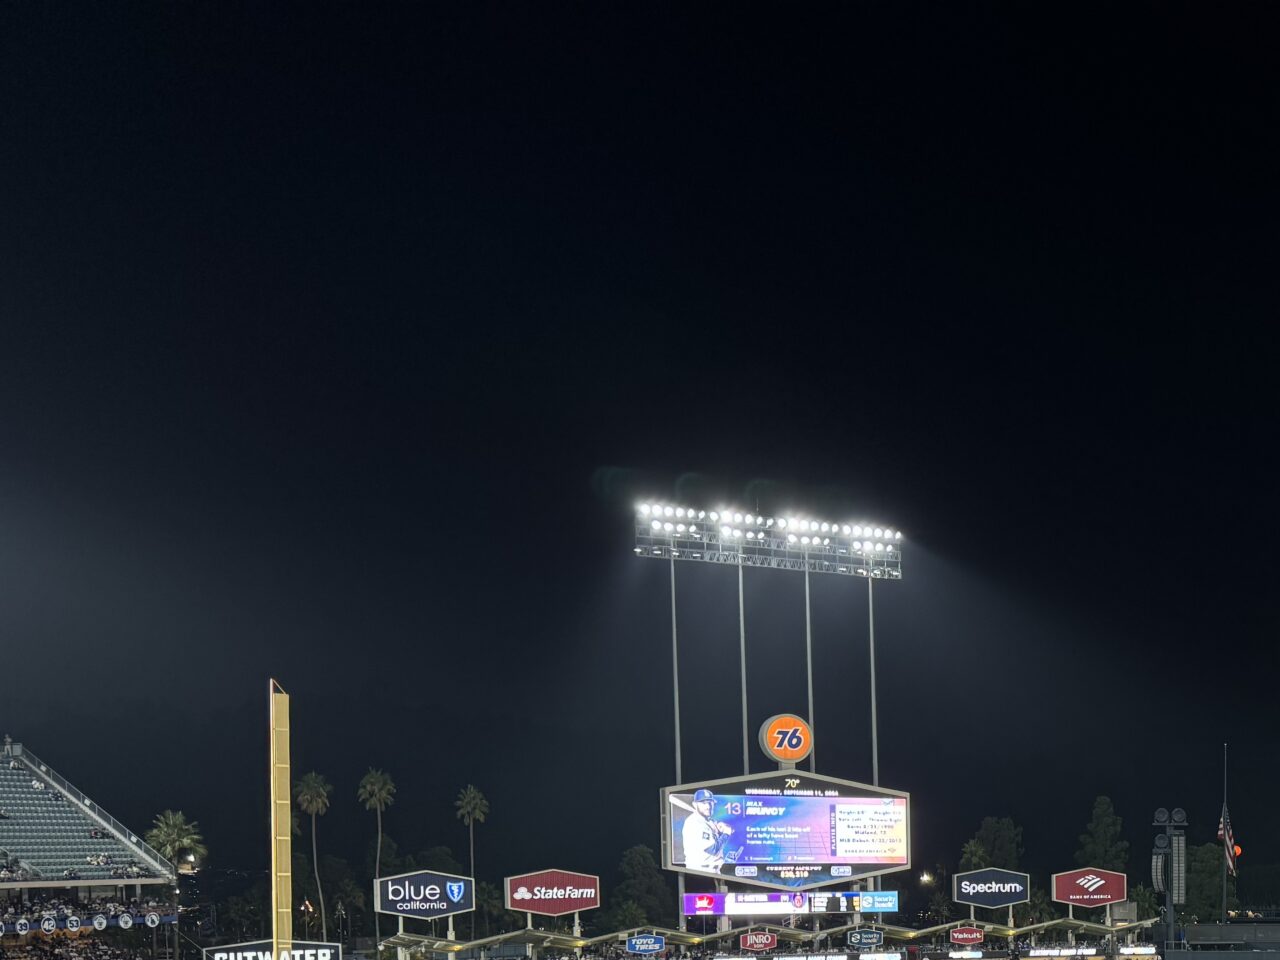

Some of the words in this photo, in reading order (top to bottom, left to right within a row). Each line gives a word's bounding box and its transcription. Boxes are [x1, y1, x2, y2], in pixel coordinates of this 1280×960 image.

[774, 728, 803, 750] 76
[725, 802, 742, 815] 13
[746, 807, 786, 816] MUNCY
[388, 880, 440, 900] blue
[961, 881, 1019, 895] Spectrum
[396, 900, 447, 910] california
[874, 896, 895, 904] Security
[746, 934, 771, 945] JINRO
